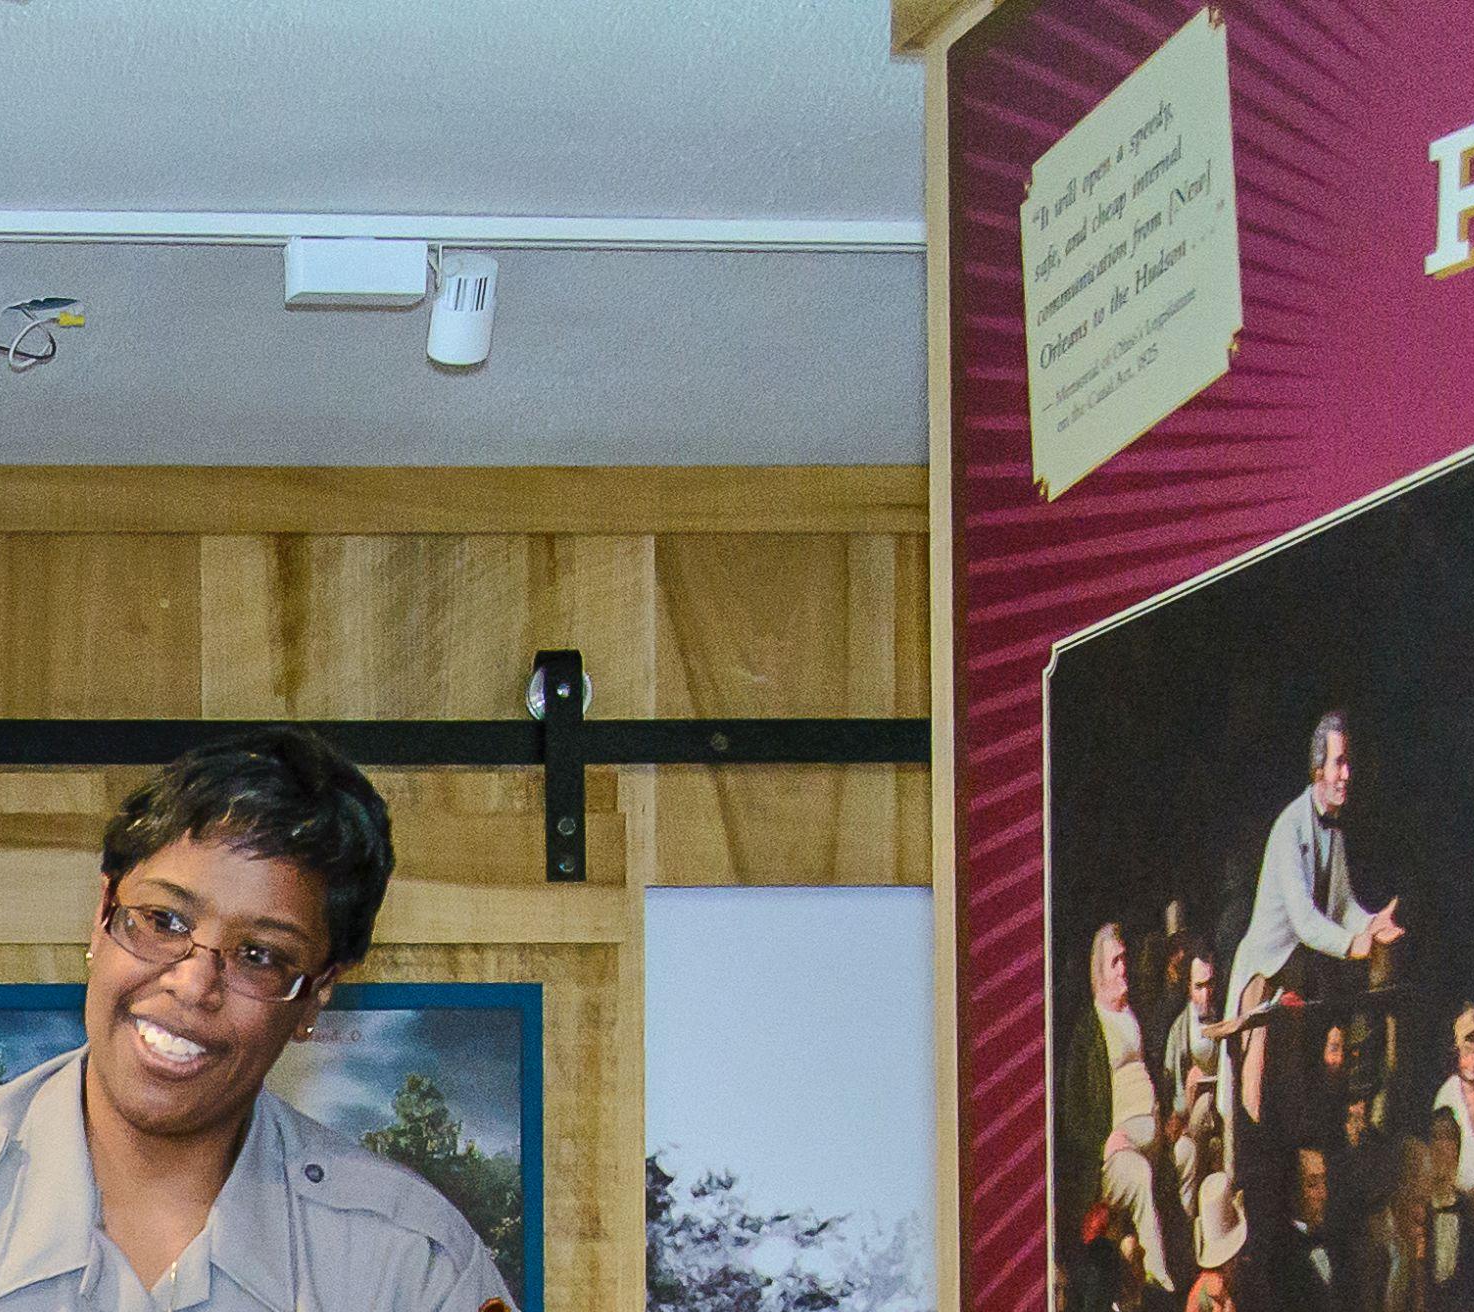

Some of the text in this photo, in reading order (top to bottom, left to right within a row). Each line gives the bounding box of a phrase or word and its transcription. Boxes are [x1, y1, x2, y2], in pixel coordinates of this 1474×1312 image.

[1034, 134, 1182, 283] safe, and cheap internal
[1054, 177, 1077, 218] will
[1082, 155, 1111, 197] open
[1116, 145, 1124, 164] a
[1037, 240, 1127, 327] communication
[1127, 211, 1162, 260] from
[1040, 240, 1186, 370] Orleans to the Hudson
